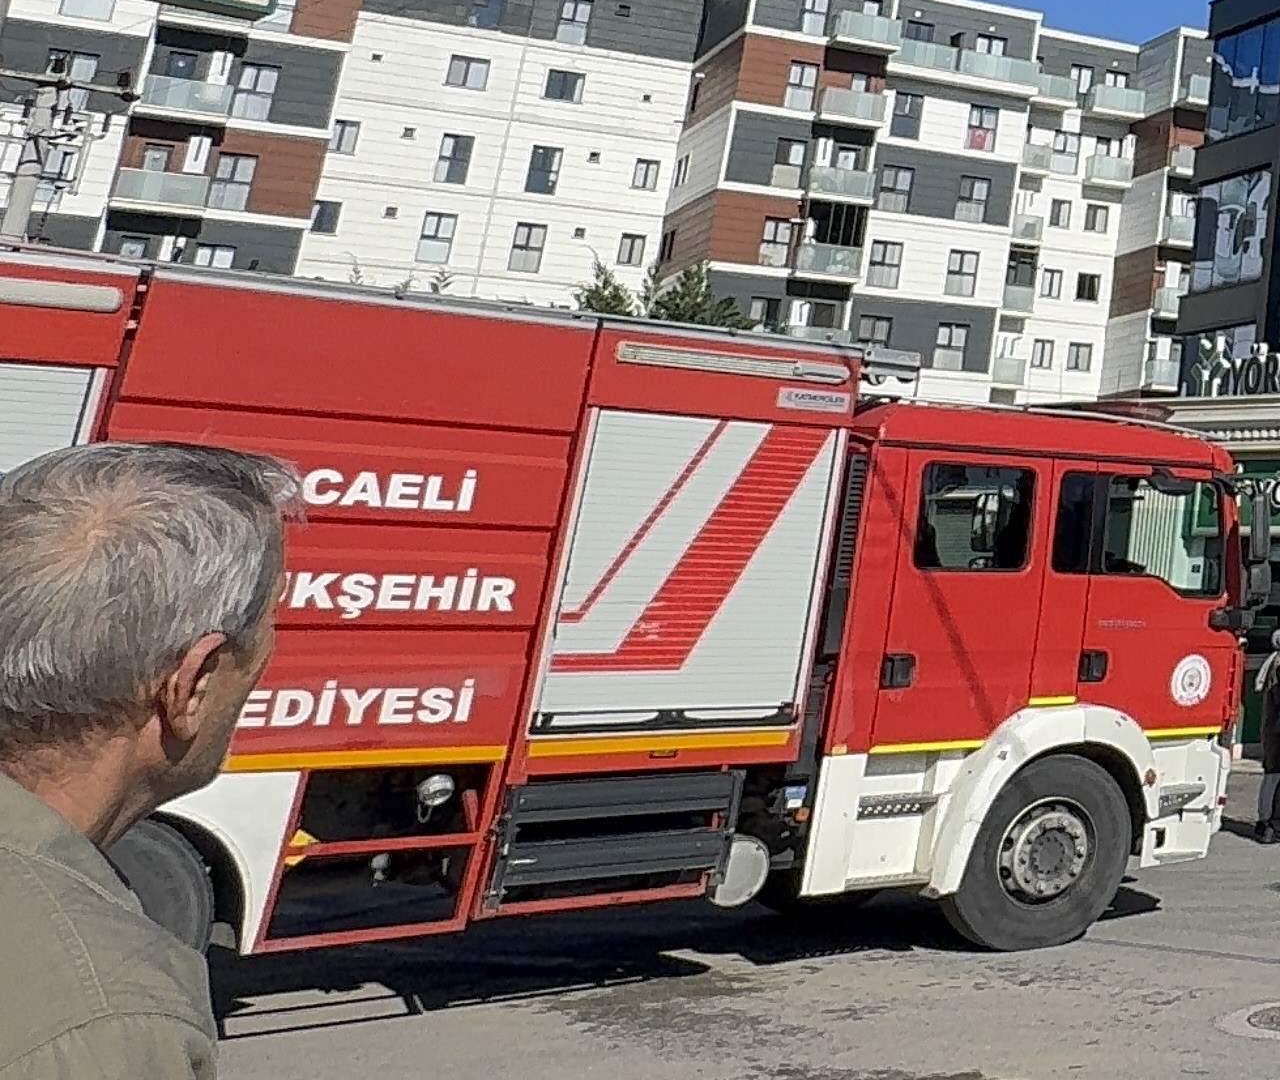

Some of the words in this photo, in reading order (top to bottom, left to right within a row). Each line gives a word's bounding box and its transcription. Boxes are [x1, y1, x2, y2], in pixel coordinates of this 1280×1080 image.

[302, 469, 477, 512] CAELİ
[279, 568, 516, 619] KŞEHİR
[240, 678, 475, 727] EDİYESİ
